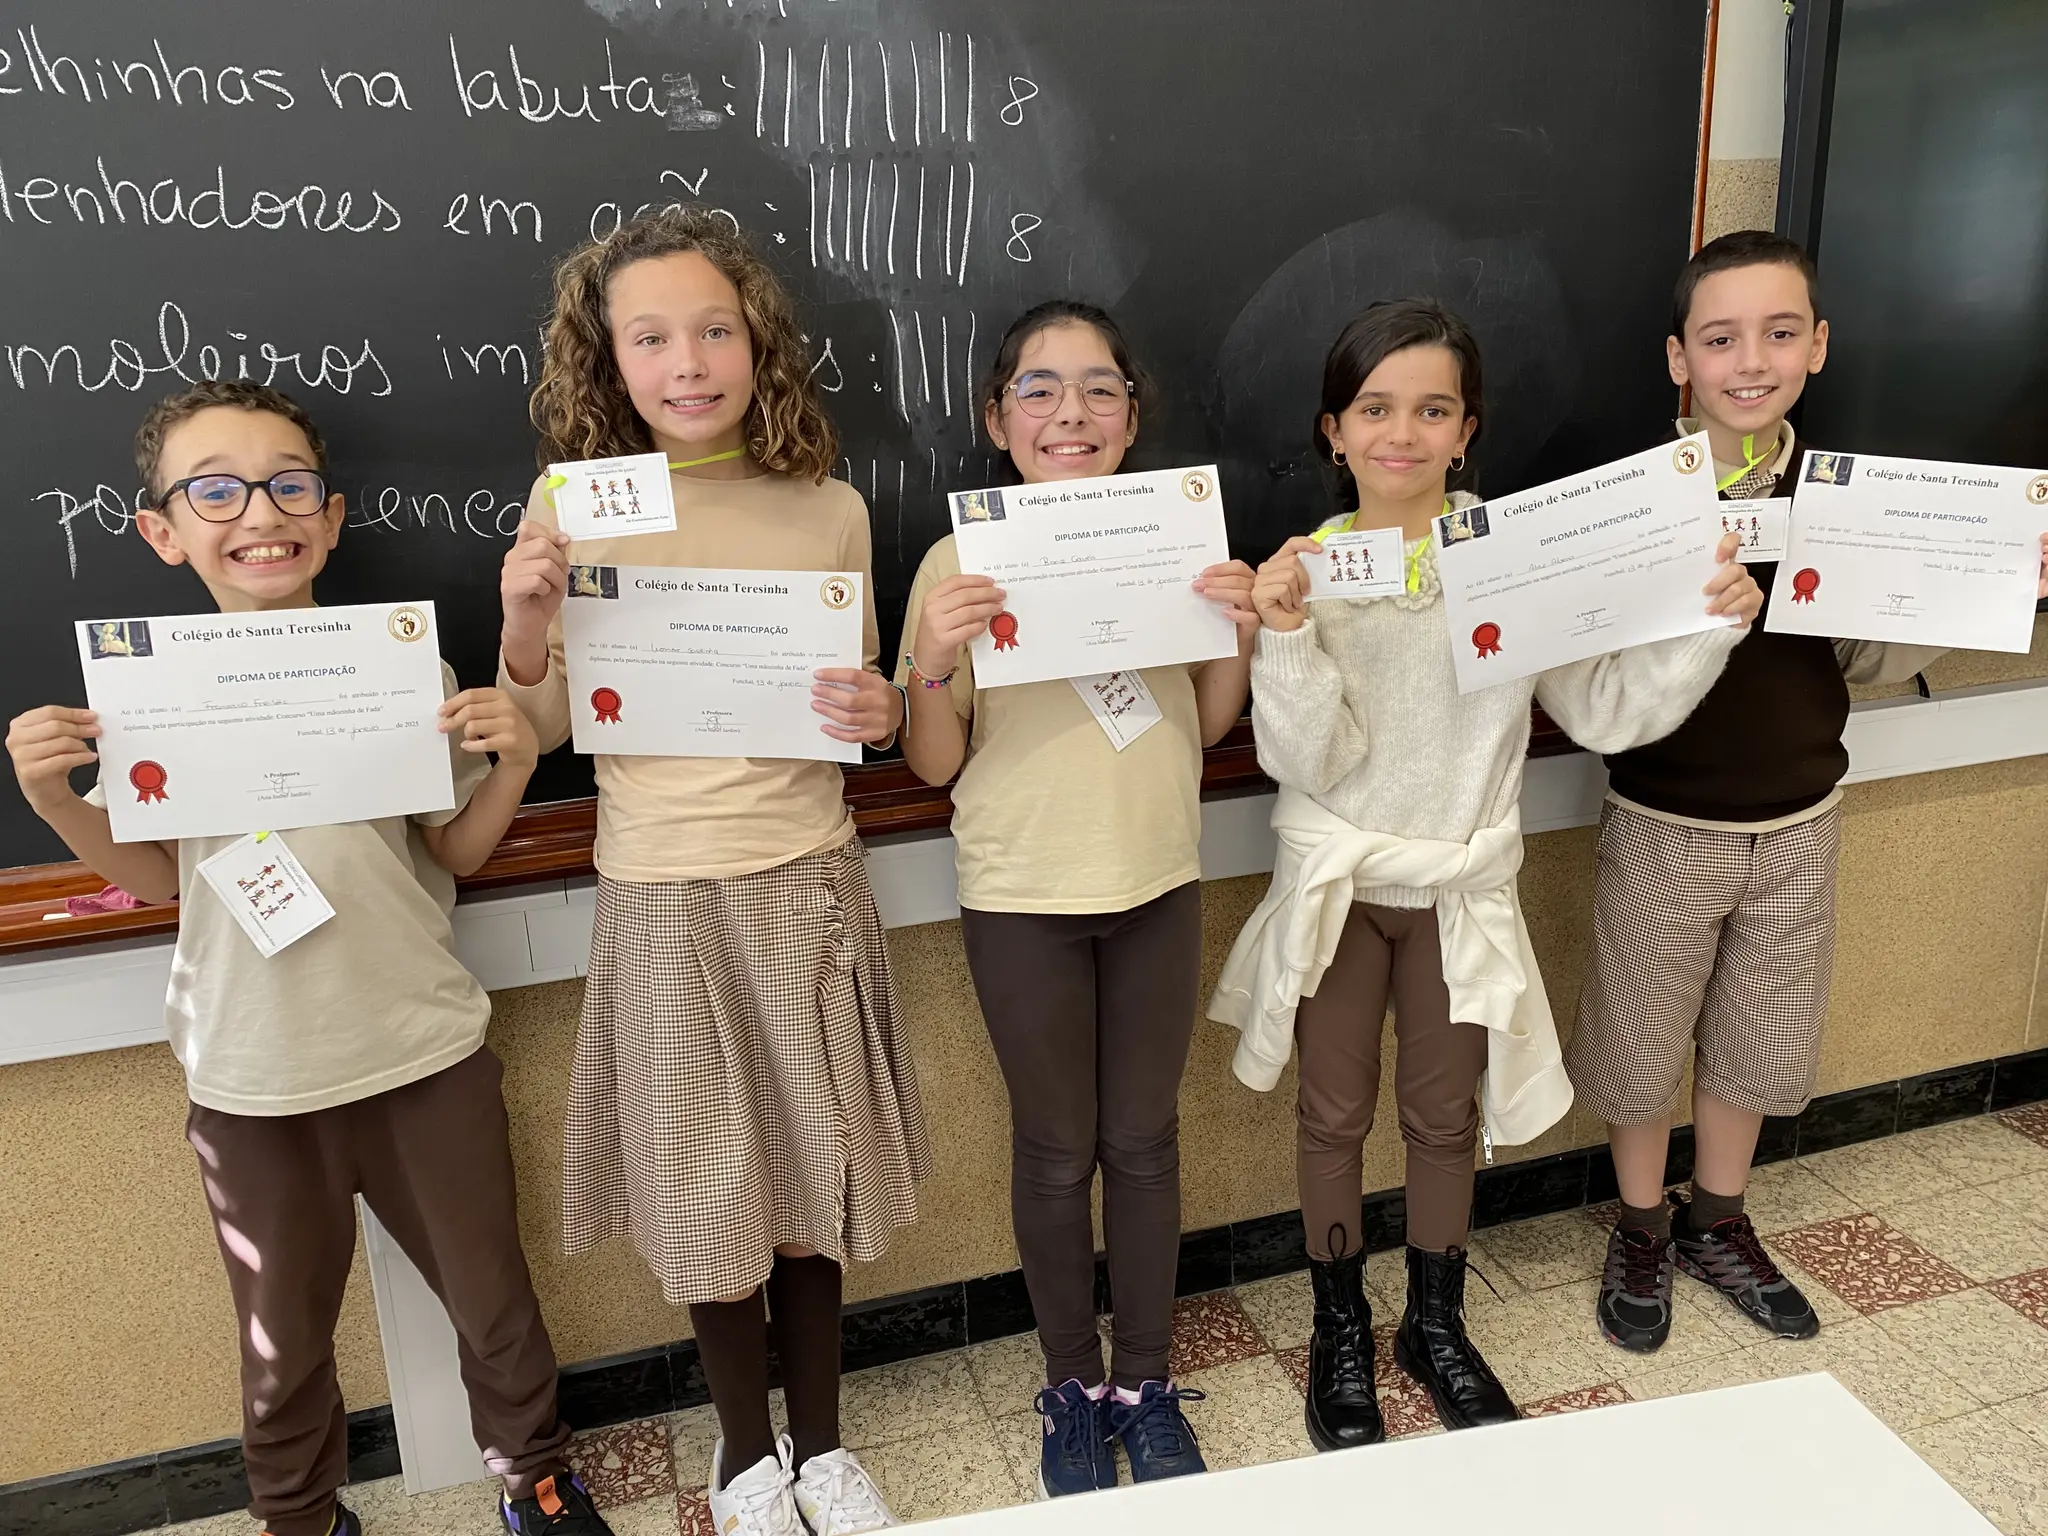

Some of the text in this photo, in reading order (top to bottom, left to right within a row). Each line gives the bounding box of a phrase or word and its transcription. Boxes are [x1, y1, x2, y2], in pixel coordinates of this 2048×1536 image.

[321, 66, 412, 112] na
[448, 33, 667, 122] labuta
[1001, 76, 1040, 126] 8
[442, 192, 543, 243] em
[1006, 212, 1042, 262] 8
[4, 301, 393, 396] moleiros
[1865, 468, 1999, 488] Colégio de Santa Teresinha
[1018, 483, 1154, 508] Colégio de Santa Teresinha
[1503, 466, 1645, 520] Colégio de Santa Teresinha
[1539, 528, 1578, 546] DIPLOMA
[1579, 524, 1591, 534] DE
[1592, 504, 1652, 531] PARTICIPAÇÃO
[1883, 508, 1988, 525] DIPLOMA DE PARTICIPAÇÃO
[1054, 521, 1159, 542] DIPLOMA DE PARTICIPAÇÃO
[635, 579, 788, 594] Colégio de Santa Teresinha
[170, 620, 351, 644] Colégio de Santa Teresinha
[669, 623, 788, 635] DIPLOMA DE PARTICIPAÇÃO
[216, 664, 356, 683] DIPLOMA DE PARTICIPAÇÃO
